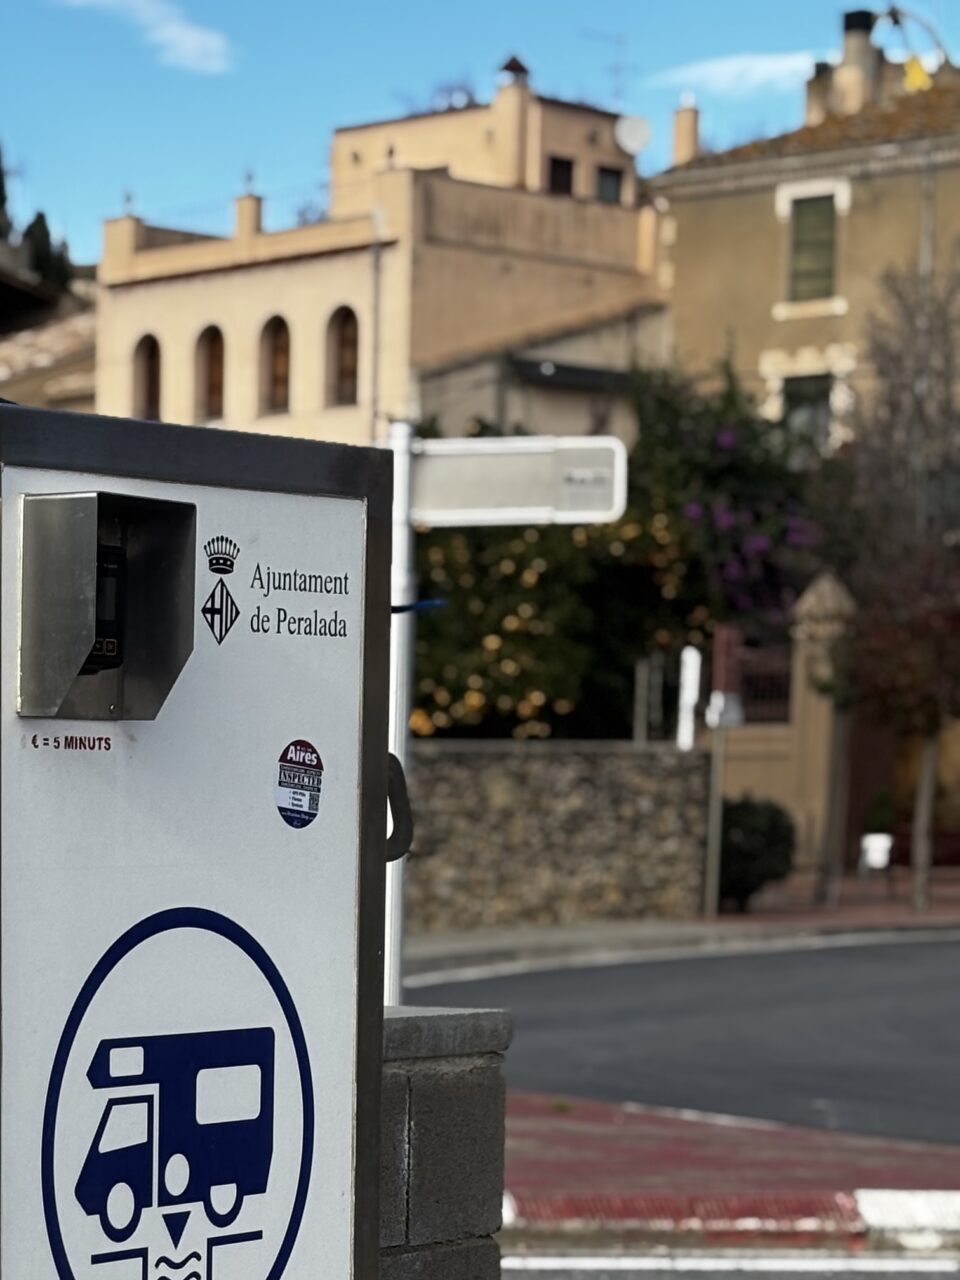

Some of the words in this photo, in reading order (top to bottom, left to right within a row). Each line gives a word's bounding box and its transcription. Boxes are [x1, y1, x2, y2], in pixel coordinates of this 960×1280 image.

[250, 562, 349, 597] Ajuntament
[250, 605, 270, 633] de
[276, 607, 347, 638] Peralada
[53, 736, 61, 750] 5
[64, 735, 112, 751] MINUTS
[287, 745, 318, 766] Aires
